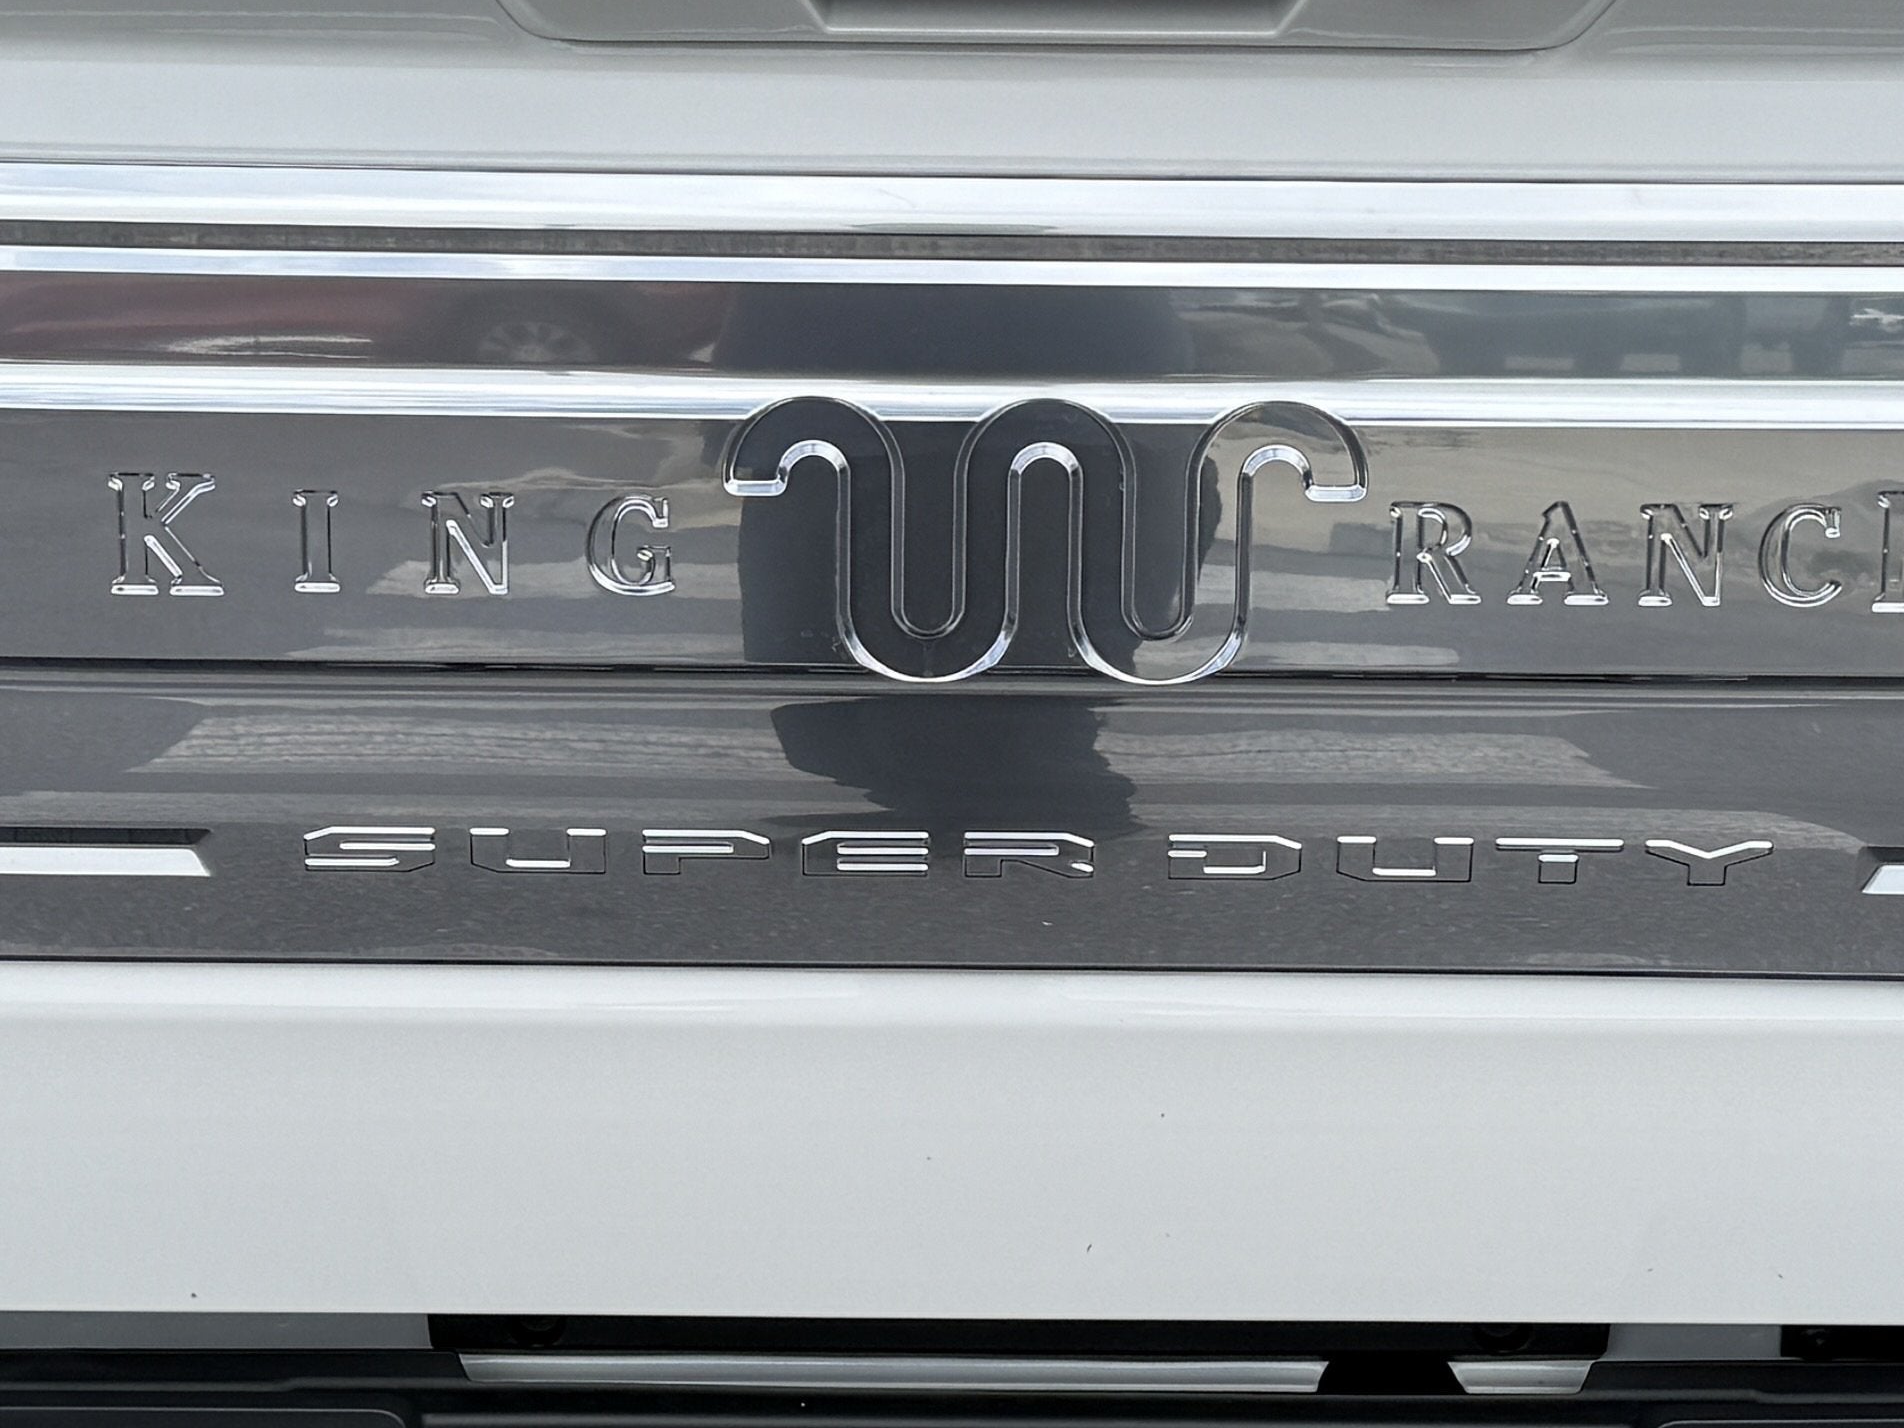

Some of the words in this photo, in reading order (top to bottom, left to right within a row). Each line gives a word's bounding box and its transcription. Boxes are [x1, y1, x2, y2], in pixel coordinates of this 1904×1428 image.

[108, 472, 676, 596] KING
[303, 825, 1095, 879] SUPER
[1166, 833, 1775, 887] DUTY
